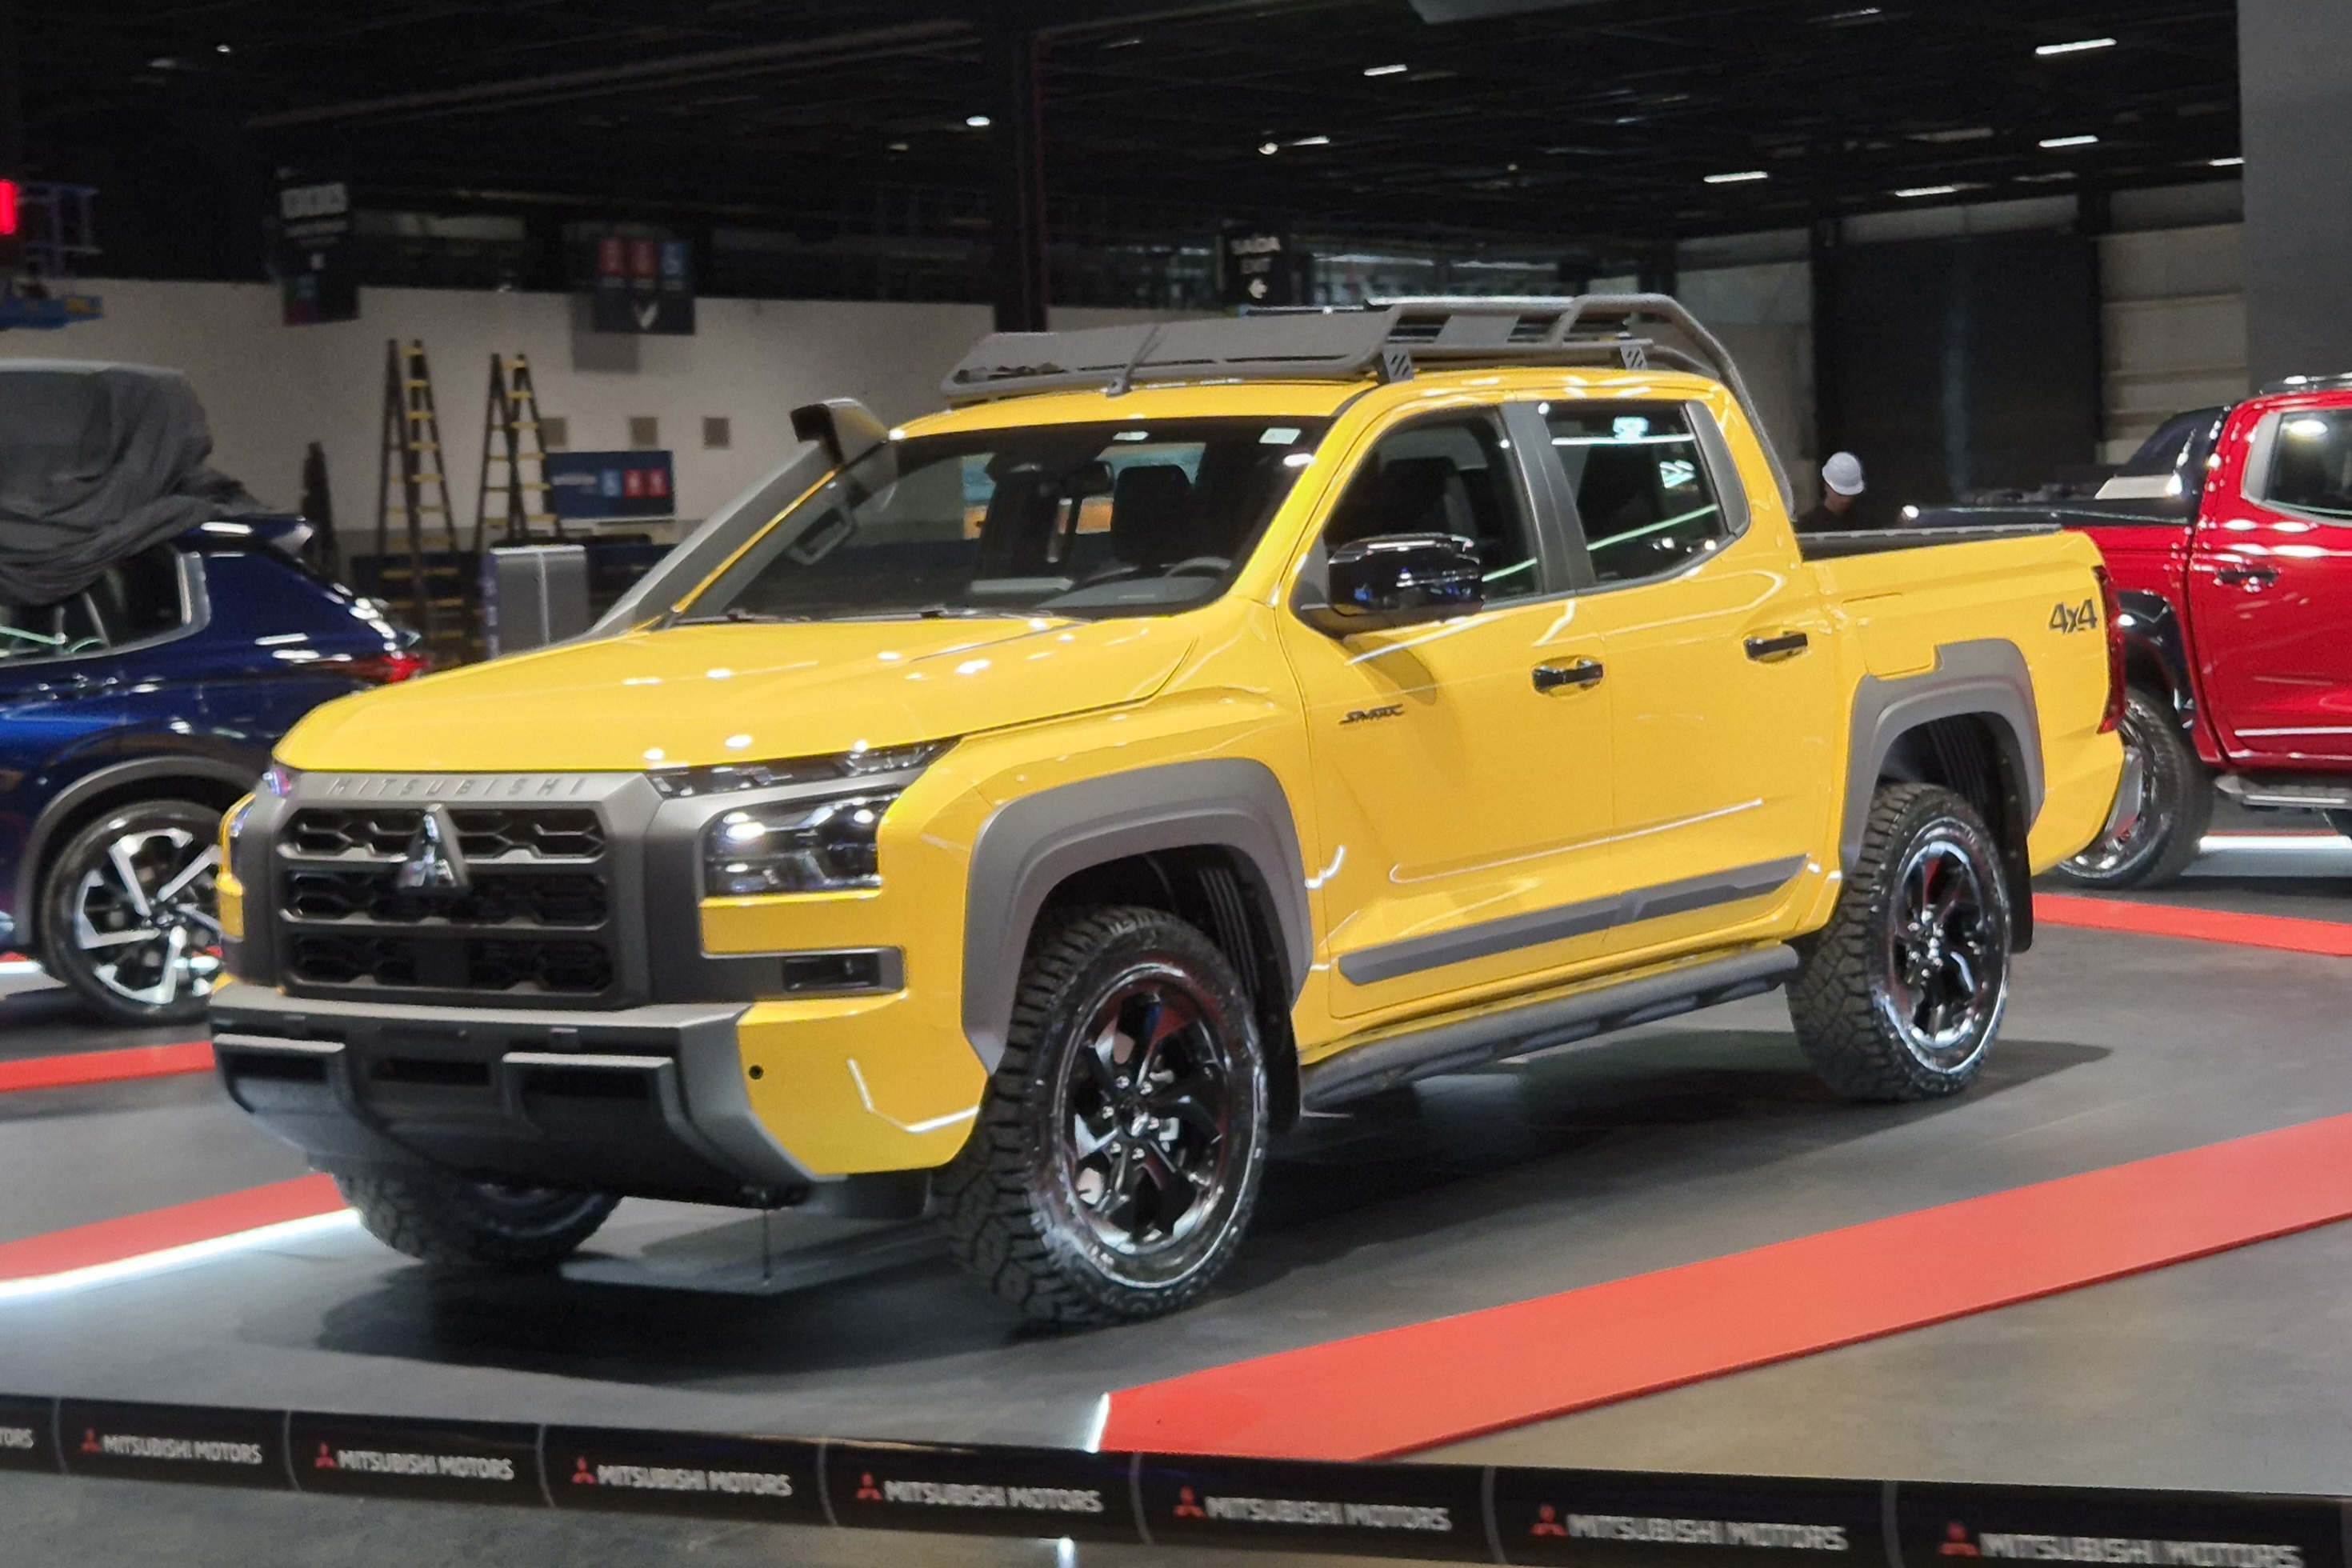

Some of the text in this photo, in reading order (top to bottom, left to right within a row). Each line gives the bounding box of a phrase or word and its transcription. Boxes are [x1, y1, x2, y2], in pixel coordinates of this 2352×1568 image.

[2048, 597, 2098, 634] 4x4
[326, 777, 586, 797] MITSUBISHI
[102, 1434, 263, 1465] MITSUBISHI MOTORS
[337, 1450, 515, 1481] MITSUBISHI MOTORS
